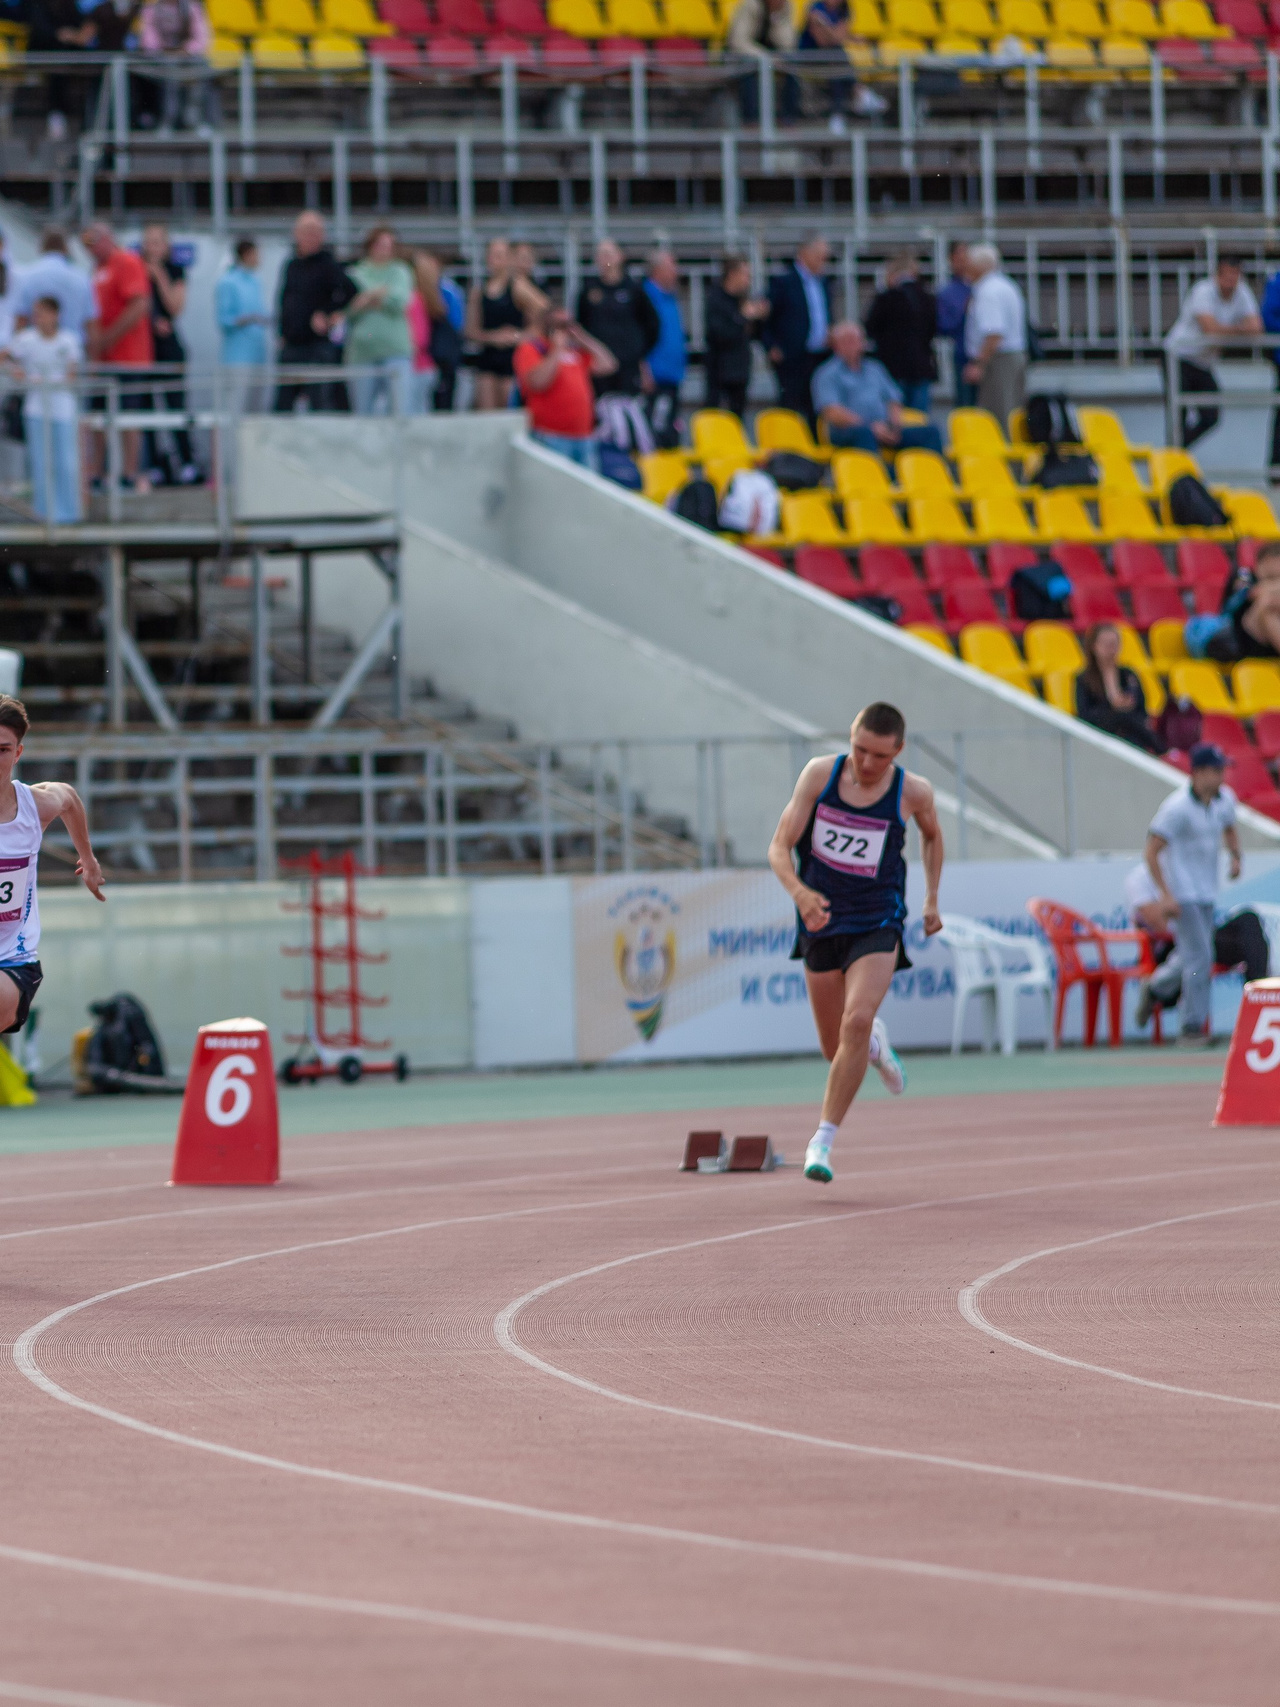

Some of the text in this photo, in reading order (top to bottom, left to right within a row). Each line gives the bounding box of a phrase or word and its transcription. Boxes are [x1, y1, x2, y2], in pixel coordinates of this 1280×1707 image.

[823, 829, 869, 859] 272
[204, 1036, 261, 1050] MONDO
[1244, 1006, 1280, 1074] 5
[204, 1053, 257, 1128] 6
